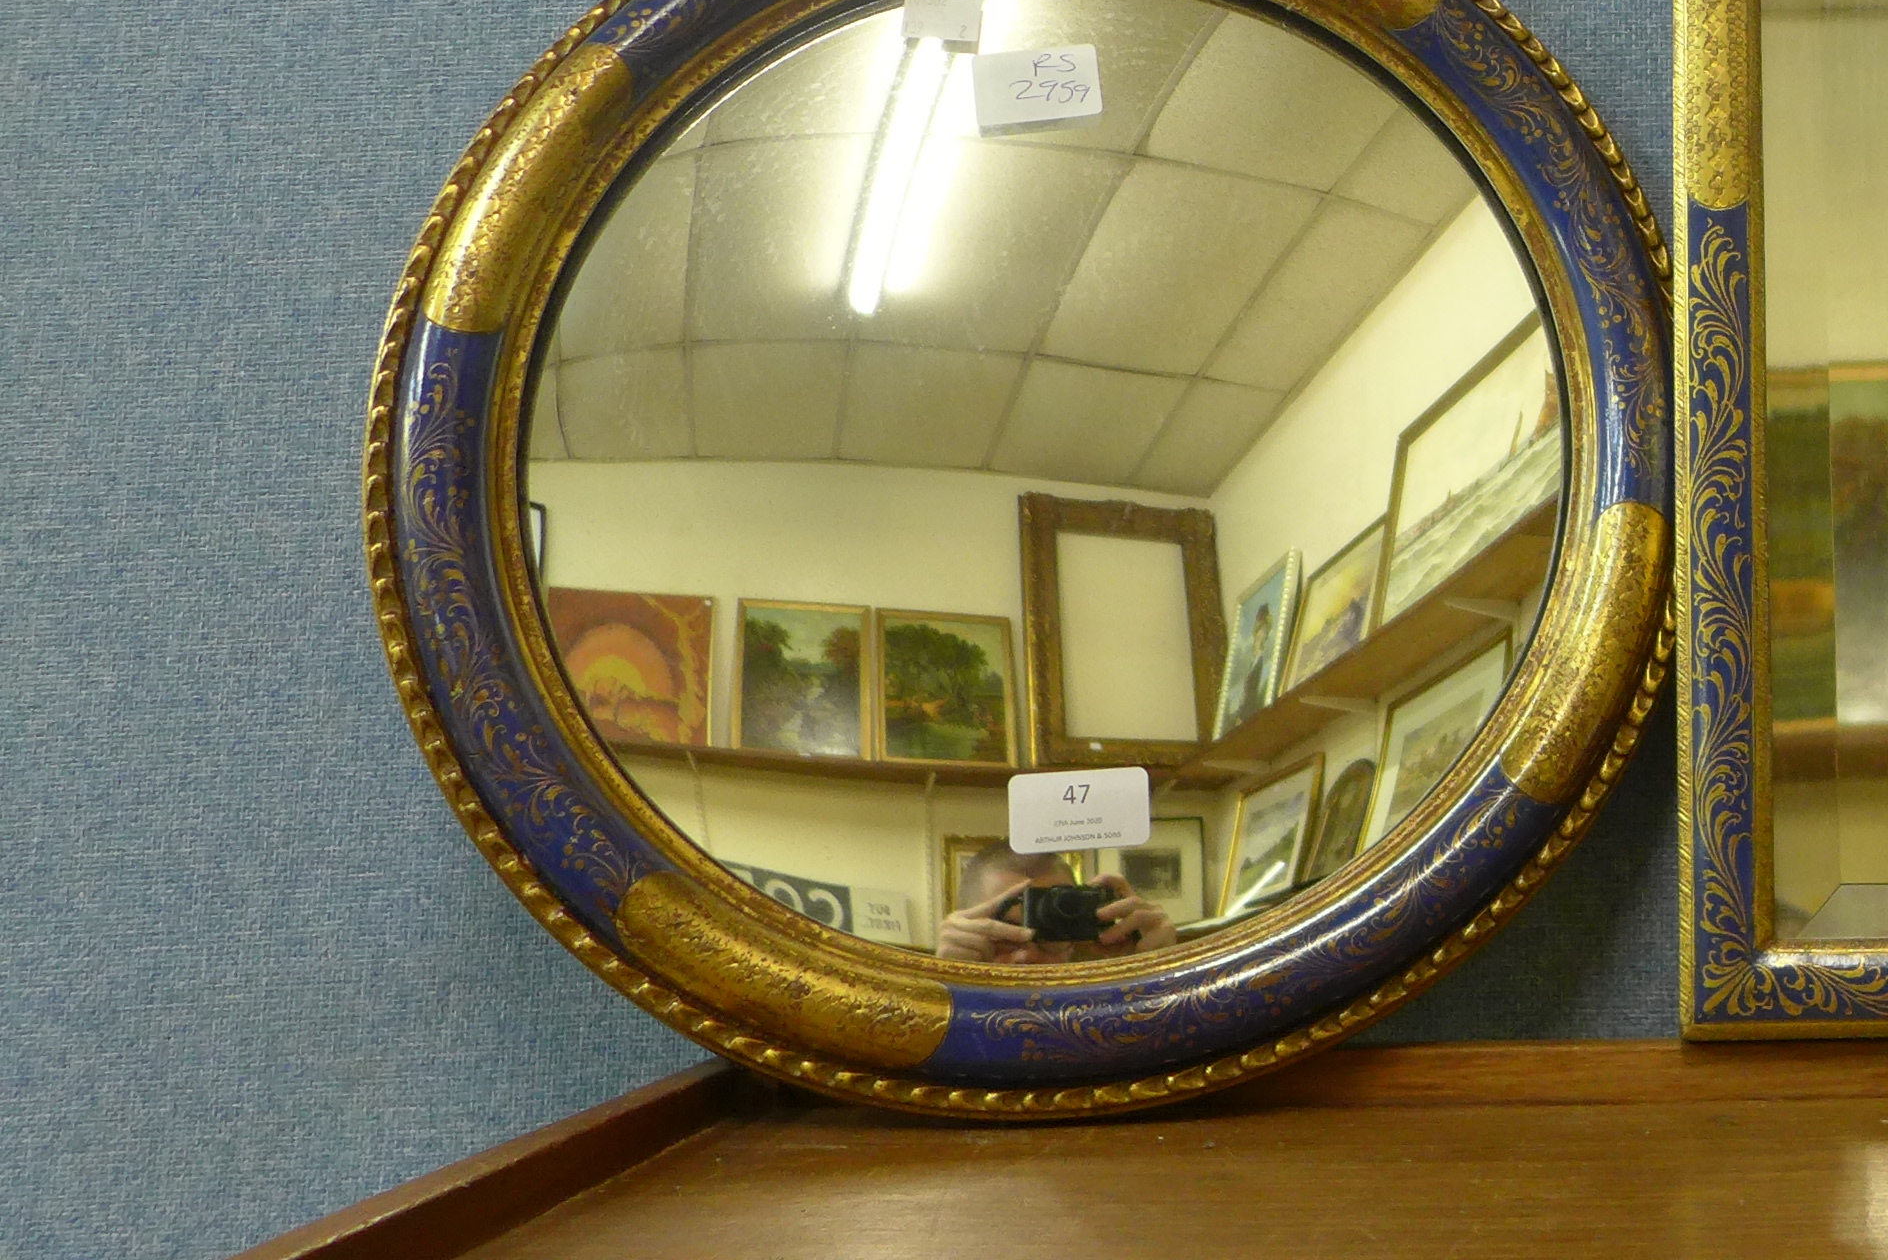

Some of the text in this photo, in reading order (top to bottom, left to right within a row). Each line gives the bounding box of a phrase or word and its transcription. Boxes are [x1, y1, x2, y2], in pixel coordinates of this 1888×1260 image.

[958, 25, 968, 39] 2
[1032, 52, 1077, 77] RS
[1009, 78, 1091, 104] 2959
[1062, 783, 1091, 805] 47
[1070, 818, 1085, 826] June
[1035, 835, 1063, 844] ARTHUR
[1064, 833, 1096, 843] JOHNSON
